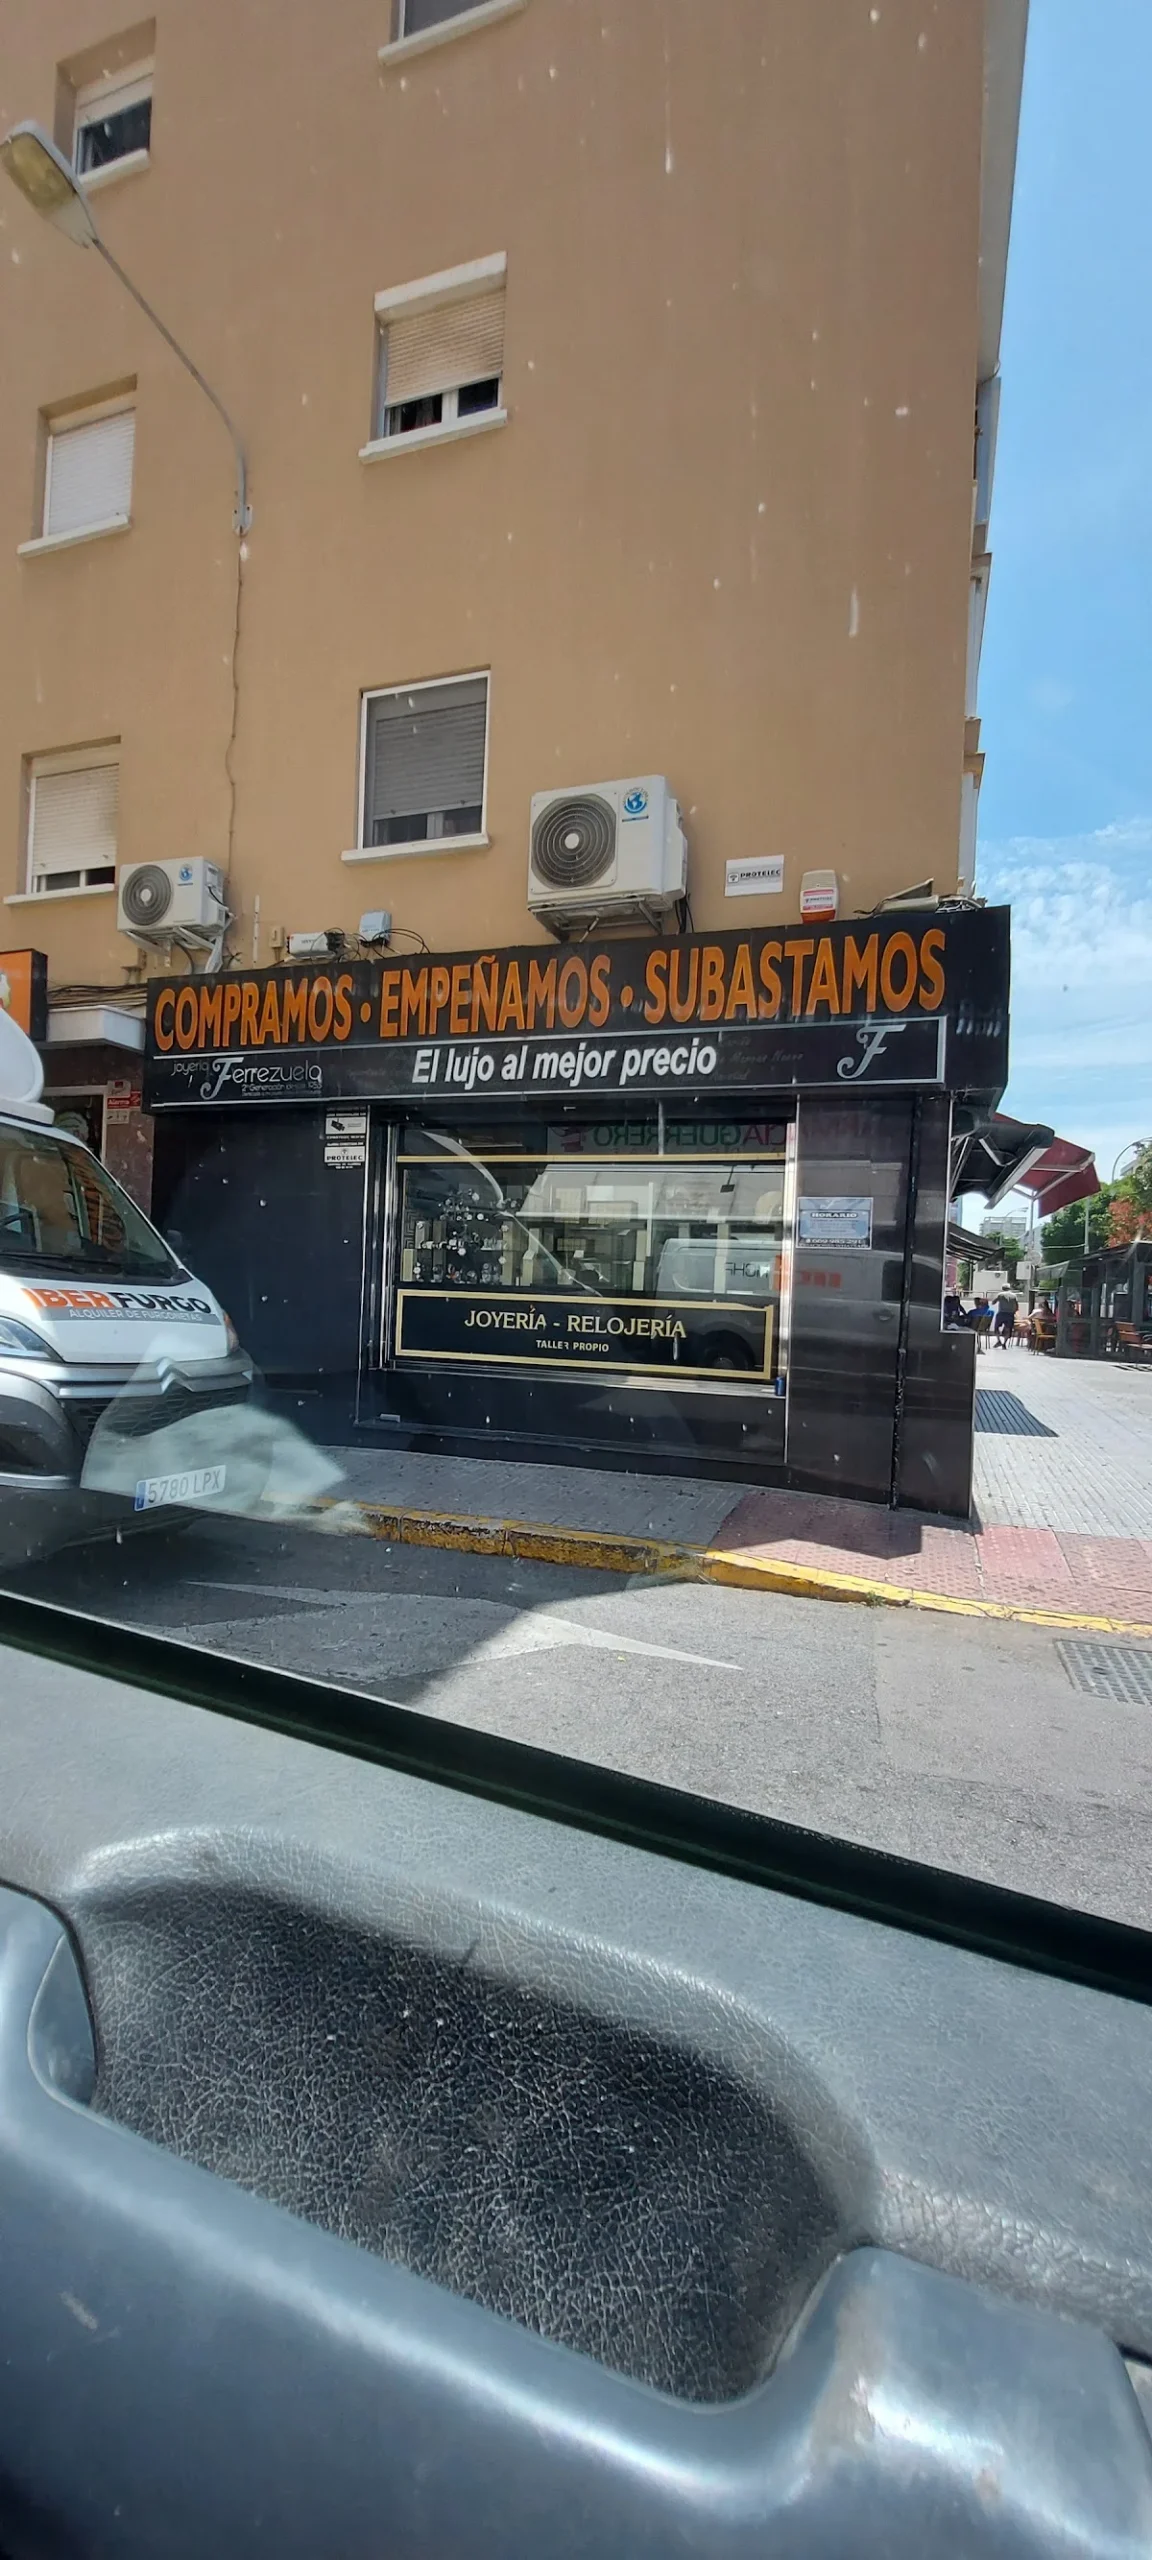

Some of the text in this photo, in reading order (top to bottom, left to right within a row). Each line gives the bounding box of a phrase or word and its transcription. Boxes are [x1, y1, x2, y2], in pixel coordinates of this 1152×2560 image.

[154, 974, 353, 1051] COMPRAMOS
[380, 954, 611, 1038] EMPEÑAMOS
[644, 928, 946, 1024] SUBASTAMOS
[200, 1057, 322, 1100] Ferrezuela
[412, 1038, 717, 1090] El lujo al mejor precio
[21, 1288, 212, 1314] IBERFURGO
[69, 1308, 204, 1322] ALQUILER DE FURGONETAS
[464, 1305, 547, 1331] JOYERÍA
[567, 1314, 687, 1339] RELOJERÍA
[572, 1341, 609, 1352] PROPIO
[148, 1470, 221, 1504] 5780 LPX
